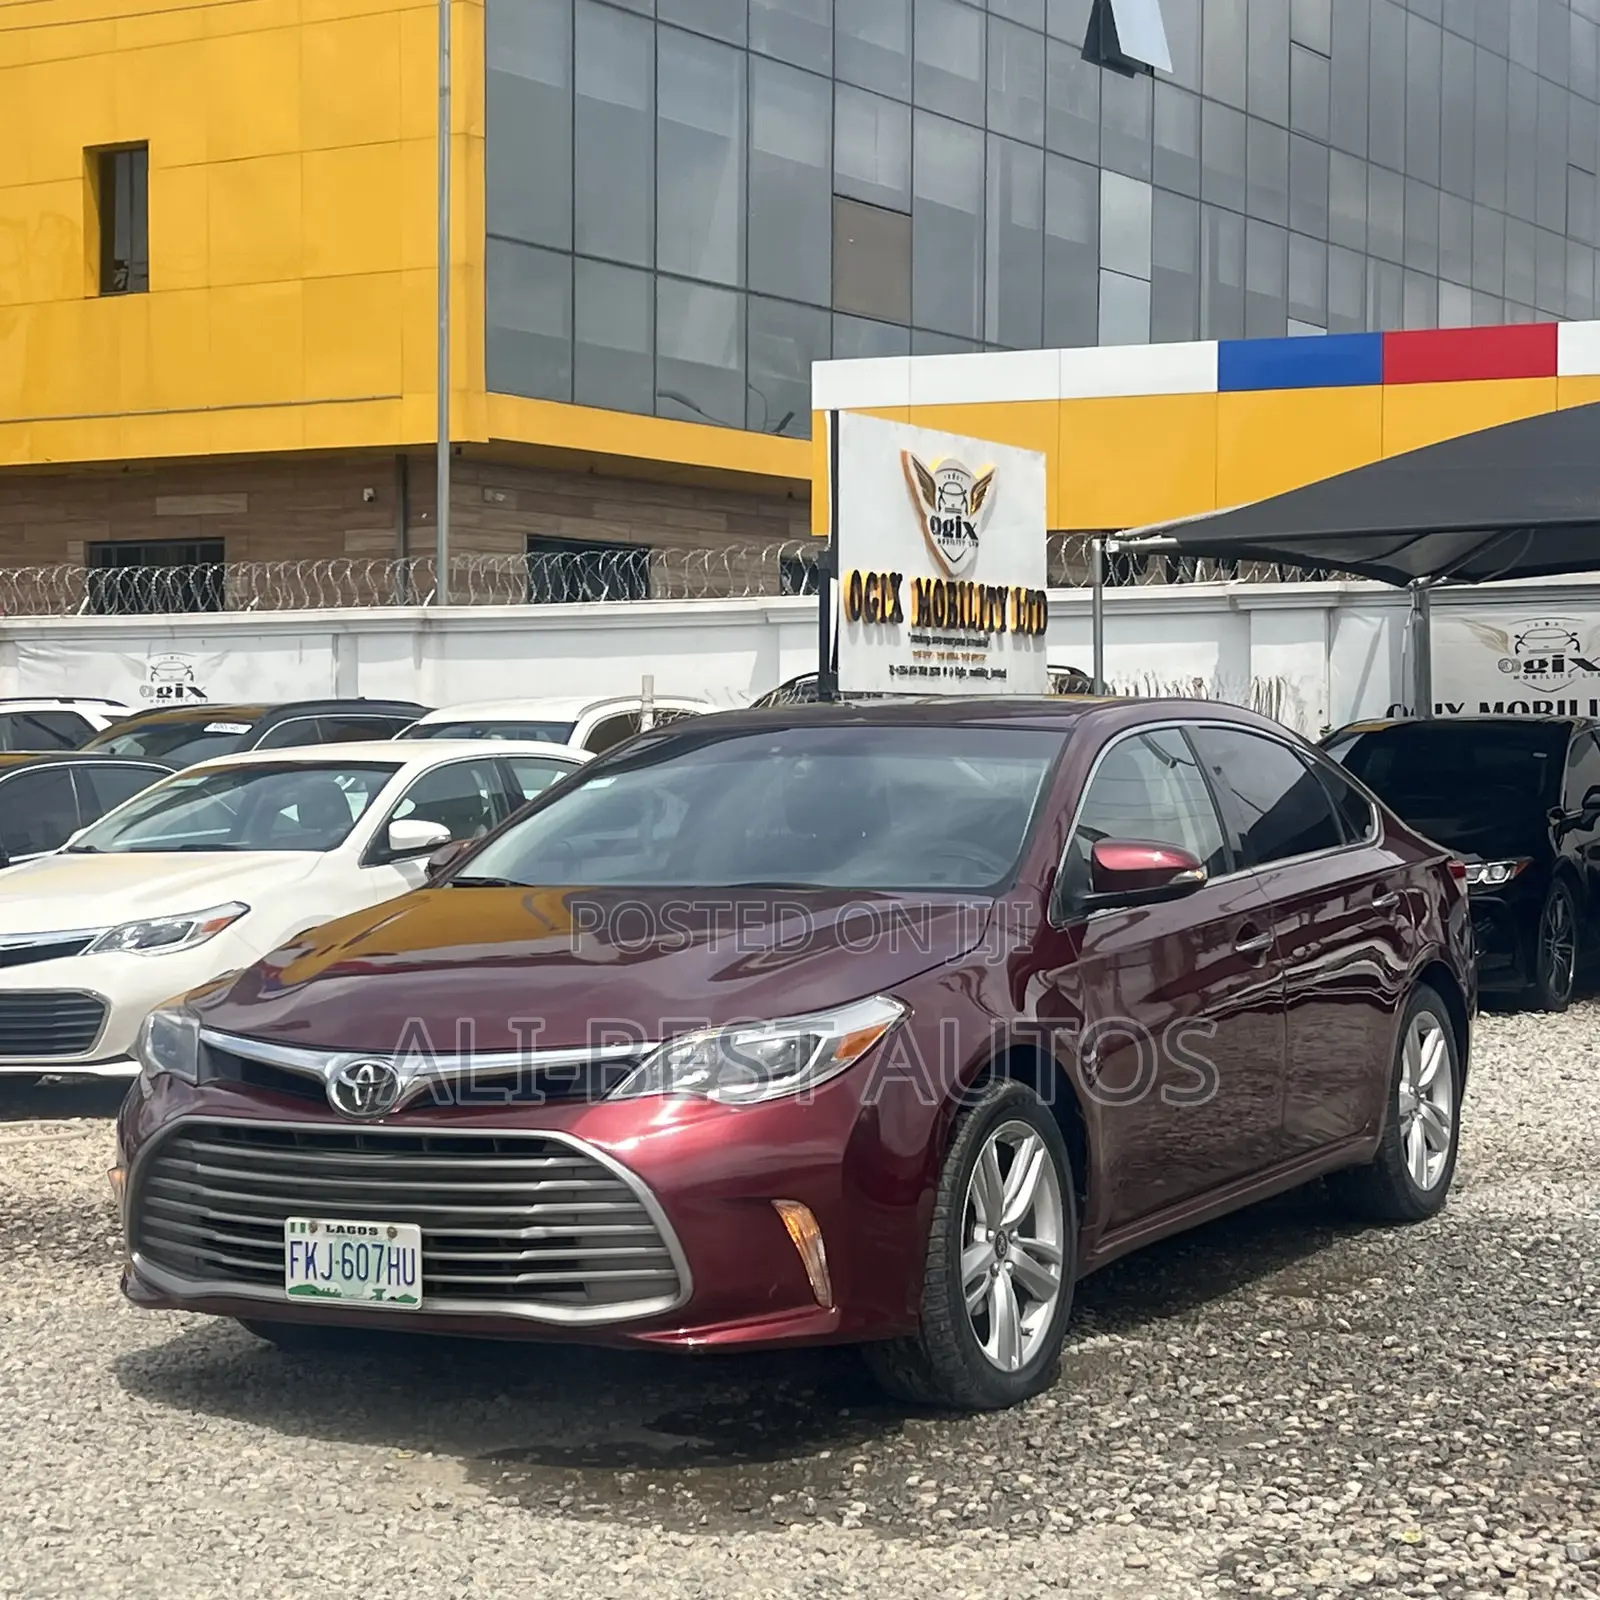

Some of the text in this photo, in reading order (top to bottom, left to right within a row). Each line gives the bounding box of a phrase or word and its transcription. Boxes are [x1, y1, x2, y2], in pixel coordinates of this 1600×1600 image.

[845, 569, 1049, 635] OGIX MOBILITY LTD
[326, 1224, 379, 1236] LAGOS
